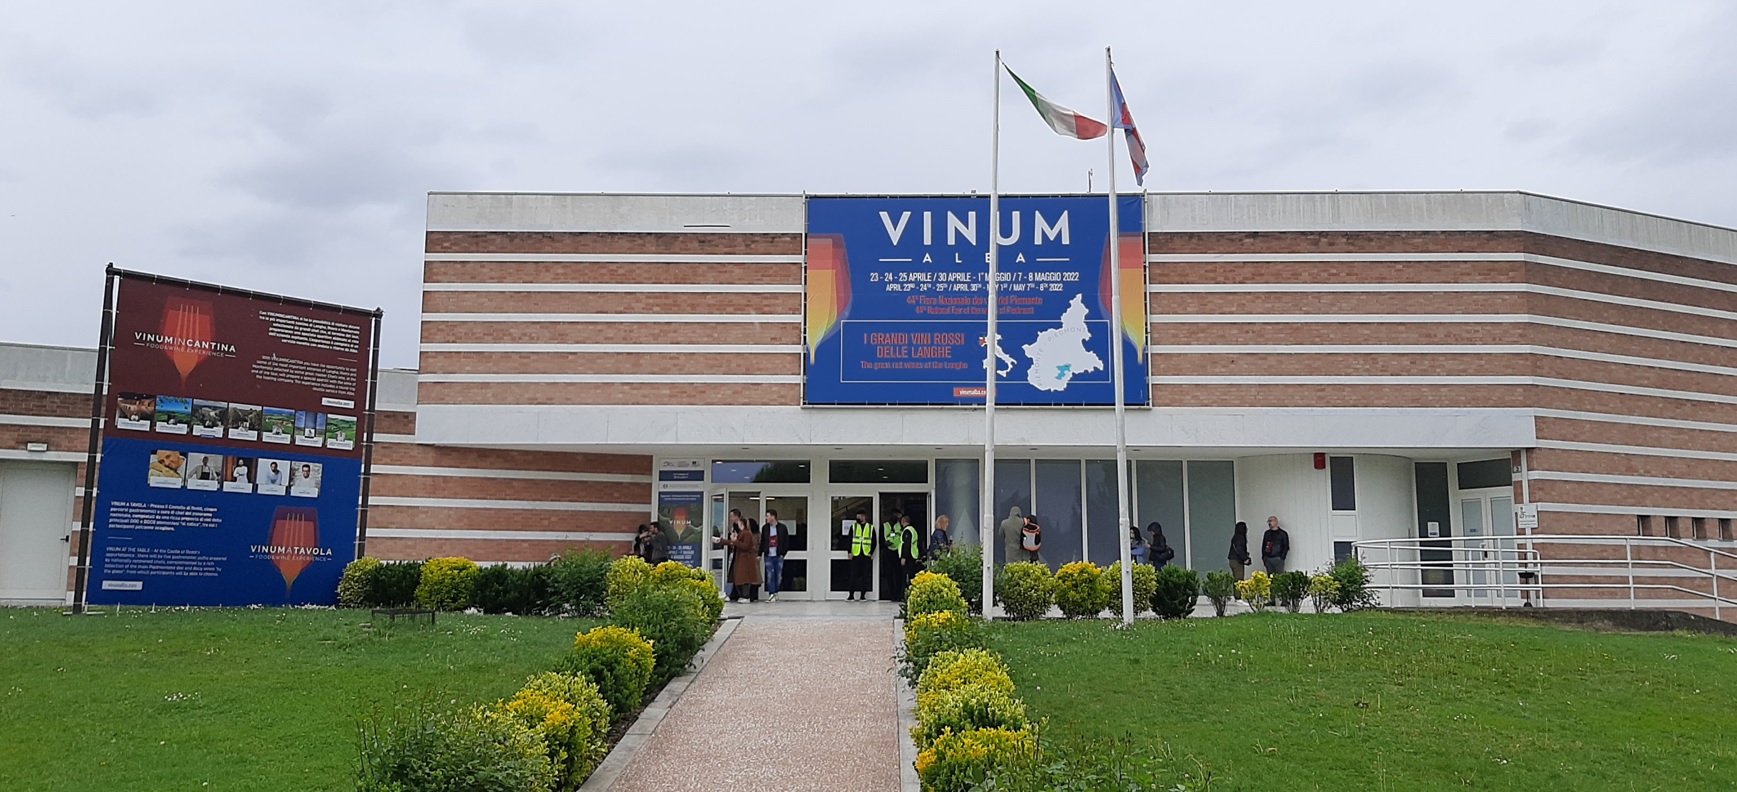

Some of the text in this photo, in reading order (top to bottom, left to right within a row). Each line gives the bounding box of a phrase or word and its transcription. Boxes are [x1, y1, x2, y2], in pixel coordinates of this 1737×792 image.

[878, 210, 1070, 246] VINUM
[923, 253, 1025, 263] ALBA
[870, 272, 878, 281] 23
[884, 272, 893, 281] 24
[899, 272, 907, 281] 25
[908, 272, 932, 281] APRILE
[938, 272, 946, 281] 30
[948, 272, 971, 281] APRILE
[985, 272, 1011, 281] MGGIO
[1018, 272, 1022, 281] 7
[1028, 272, 1033, 281] 8
[1035, 272, 1061, 281] MAGGIO
[1063, 272, 1079, 281] 2022
[134, 332, 236, 352] VINUMINCANTINA
[864, 333, 965, 344] I GRANDI VINI ROSSI
[877, 346, 952, 358] DELLE LANGHE
[250, 545, 332, 555] VINUMATAVOLA
